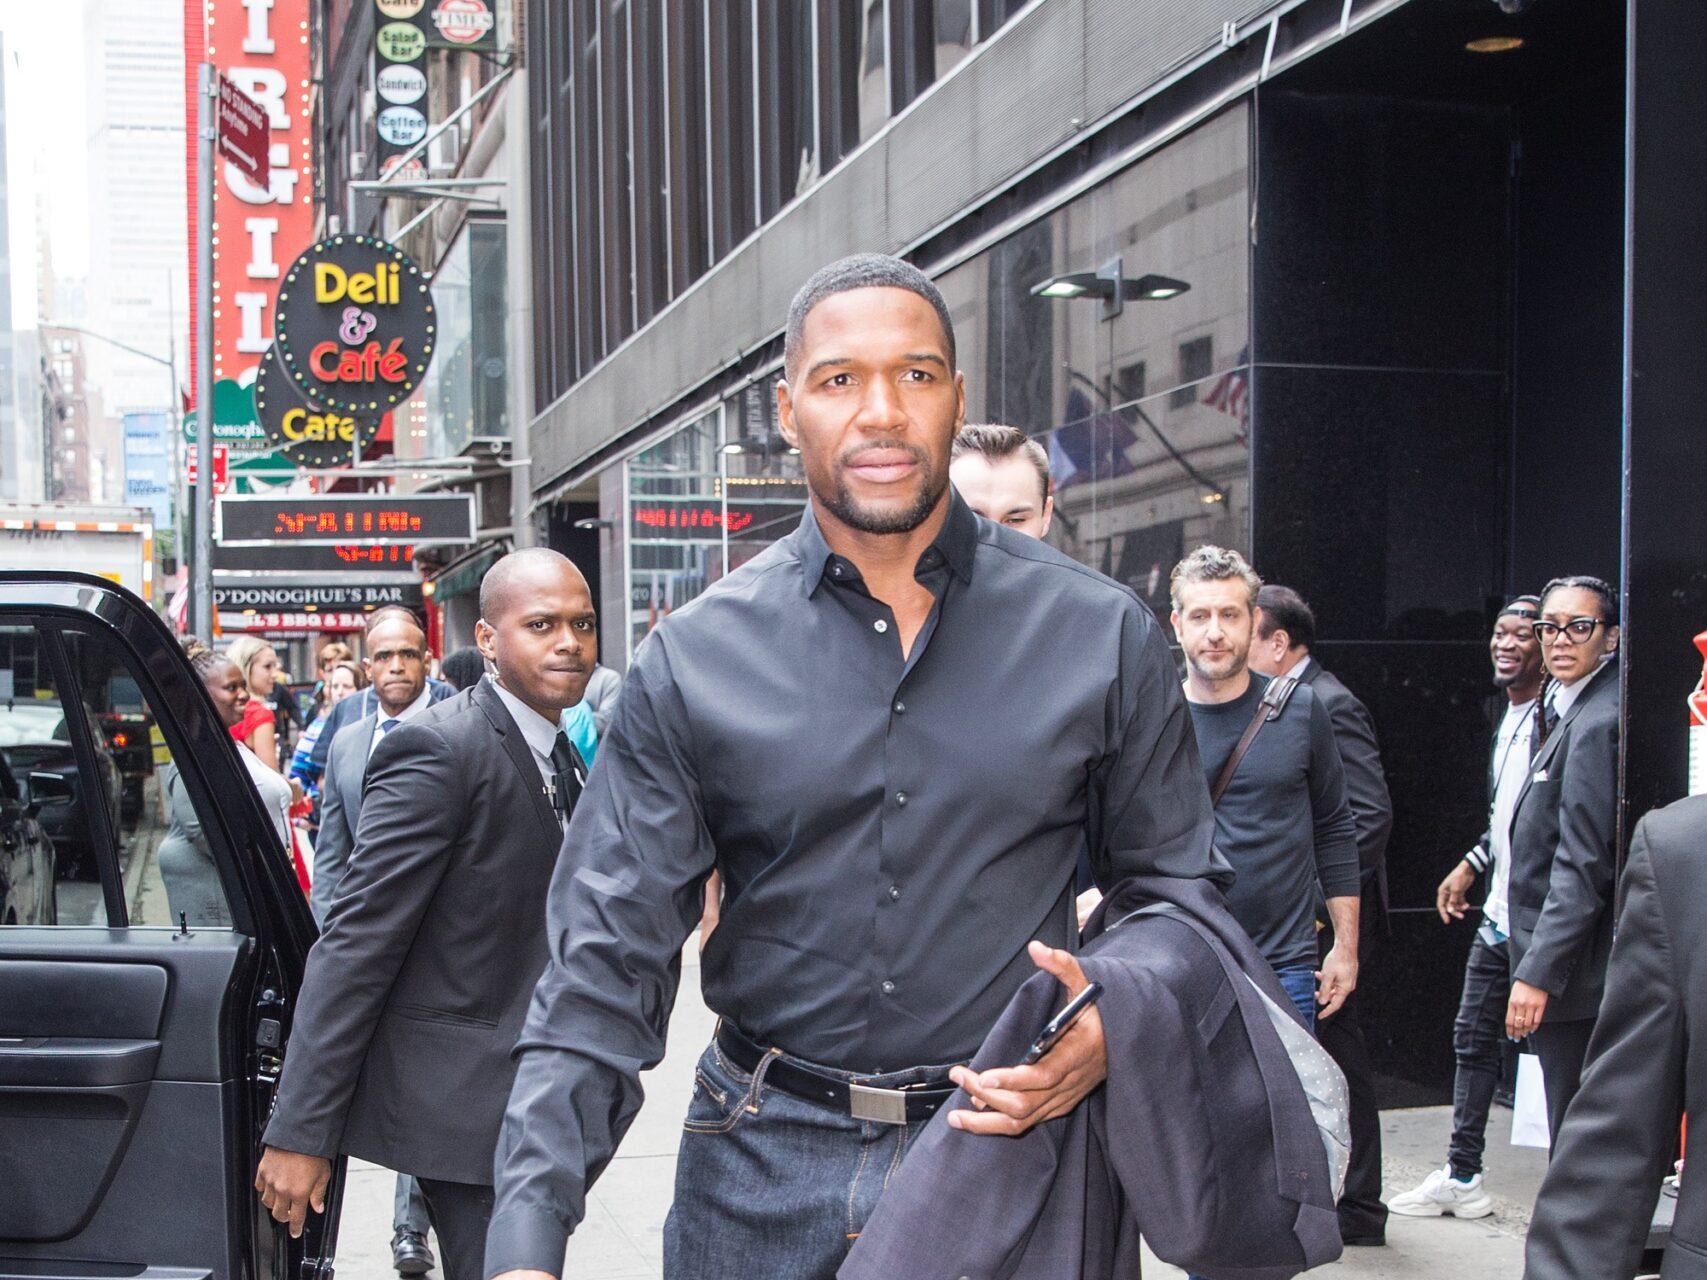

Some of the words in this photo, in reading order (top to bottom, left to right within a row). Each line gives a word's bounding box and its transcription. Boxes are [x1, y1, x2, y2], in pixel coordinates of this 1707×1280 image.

[382, 31, 418, 43] Salad
[391, 45, 413, 56] Bar
[221, 84, 232, 104] NO
[232, 92, 263, 130] STANDING
[380, 116, 424, 128] Coffee
[392, 129, 413, 140] Bar
[314, 262, 400, 304] Deli
[339, 306, 377, 345] &
[309, 337, 408, 382] Café
[214, 588, 361, 604] O'DONOGHUE'S
[365, 587, 402, 602] BAR
[282, 613, 322, 627] BBQ
[324, 614, 337, 627] &
[339, 613, 371, 627] BA
